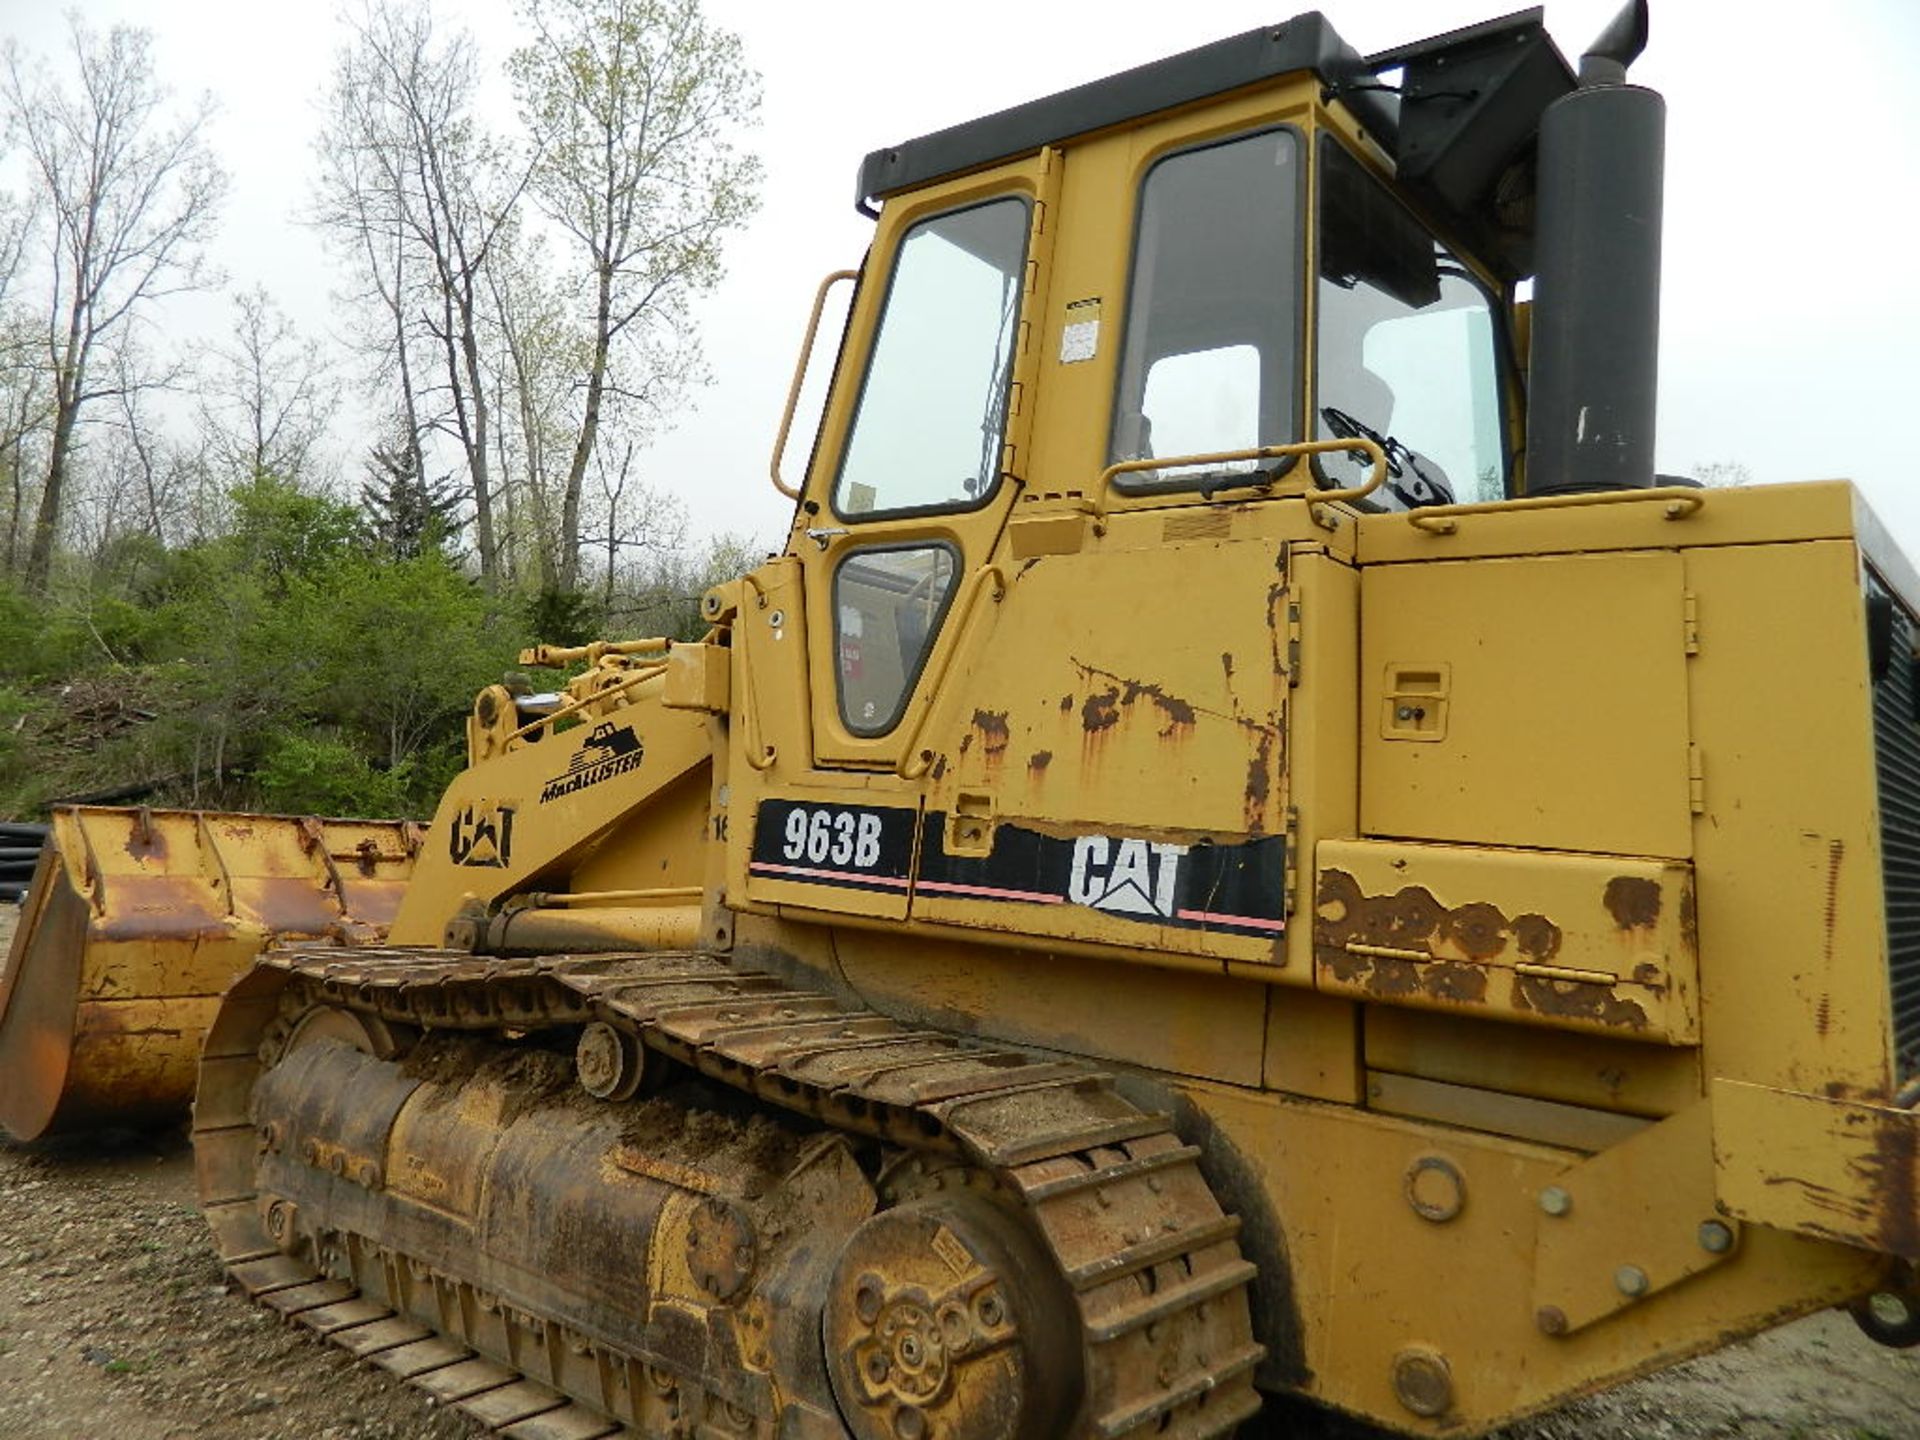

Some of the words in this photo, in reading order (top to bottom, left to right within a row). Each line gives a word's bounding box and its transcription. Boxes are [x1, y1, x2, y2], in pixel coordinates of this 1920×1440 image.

[449, 803, 516, 868] CAT
[783, 808, 882, 867] 963B
[1068, 835, 1189, 918] CAT
